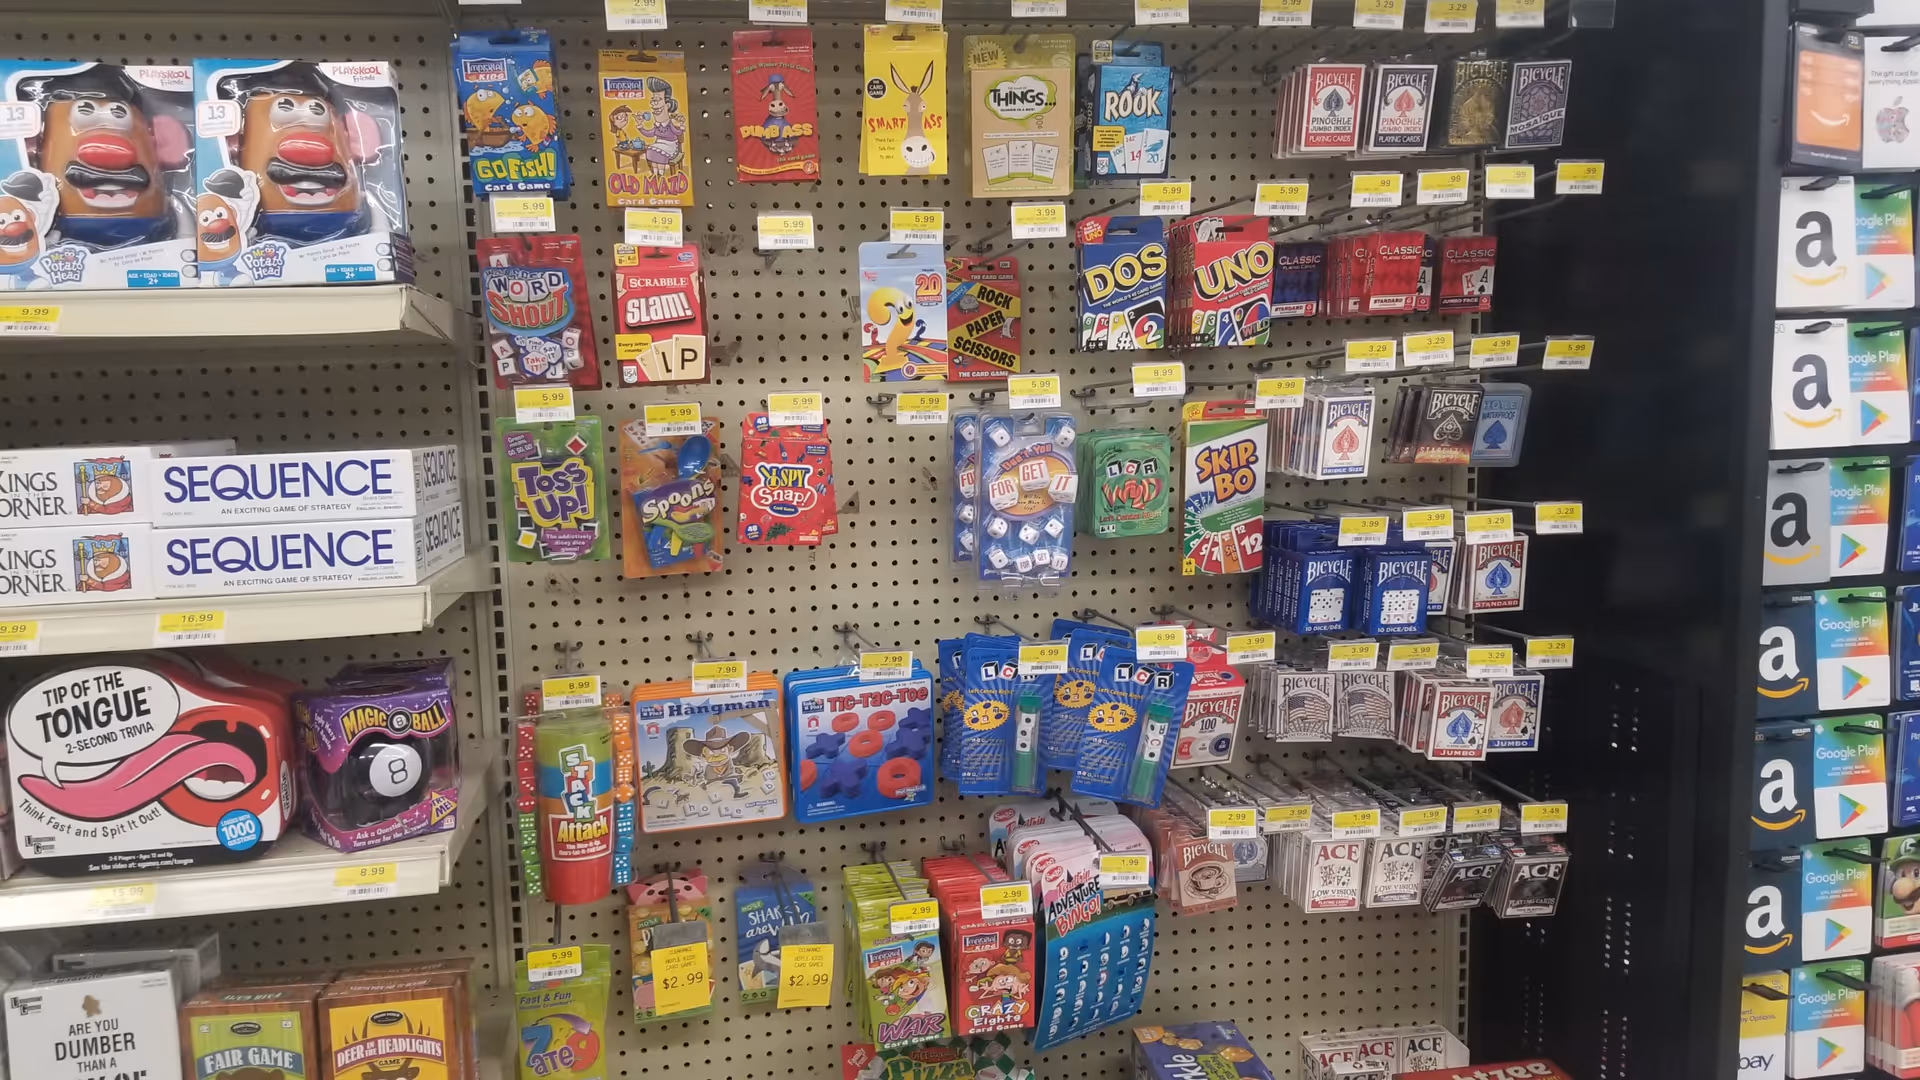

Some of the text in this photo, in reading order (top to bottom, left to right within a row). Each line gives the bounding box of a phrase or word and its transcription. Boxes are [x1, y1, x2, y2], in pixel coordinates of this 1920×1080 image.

[972, 51, 999, 64] NEW
[139, 69, 190, 80] PLAYSKOOL
[332, 65, 381, 78] PLAYSKOOL
[1455, 62, 1507, 87] BICYCLE
[1519, 67, 1565, 92] BICYCLE
[1315, 73, 1355, 94] BICYCLE
[1386, 74, 1427, 94] BICYCLE
[1104, 87, 1161, 121] ROOK
[869, 114, 942, 133] SMART ASS
[1311, 117, 1352, 125] PINOCHLE
[1381, 117, 1422, 126] PINOCHLE
[740, 123, 813, 139] DUMB ASS
[477, 159, 506, 179] GO
[485, 182, 551, 191] Card Game
[609, 174, 689, 194] OLD MAID
[651, 217, 673, 225] 4.99
[1379, 245, 1422, 255] CLASSIC
[1446, 248, 1495, 259] CLASSIC
[1279, 255, 1320, 266] CLASSIC
[50, 271, 81, 283] Head
[252, 269, 282, 281] Head
[1084, 244, 1167, 303] DOS
[1198, 244, 1274, 298] UNO
[492, 272, 562, 301] WORD
[628, 277, 688, 289] SCRABBLE
[916, 275, 941, 295] 20
[486, 287, 567, 326] SHOUT
[977, 285, 1011, 309] ROCK
[21, 308, 49, 316] 9.99
[965, 310, 1003, 336] PAPER
[1241, 319, 1269, 340] WILD
[954, 336, 1016, 369] SCISSORS
[1492, 340, 1511, 348] 4.99
[1277, 382, 1296, 390] 9.99
[1431, 392, 1480, 412] BICYCLE
[1330, 403, 1369, 421] BICYCLE
[424, 450, 457, 486] SEQUENCE
[782, 468, 807, 487] SPY
[164, 458, 393, 503] SEQUENCE
[992, 462, 1071, 498] FOR GET IT
[1214, 473, 1254, 497] BO
[643, 479, 715, 522] Spoons
[759, 488, 810, 505] Snap!
[235, 506, 271, 514] EXCITING
[311, 503, 352, 511] STRATEGY
[425, 507, 461, 552] SEQUENCE
[167, 529, 394, 575] SEQUENCE
[1242, 535, 1263, 554] 12
[1479, 543, 1521, 561] BICYCLE
[1307, 560, 1352, 584] BICYCLE
[1378, 560, 1426, 585] BICYCLE
[1475, 600, 1520, 608] STANDARD
[181, 613, 214, 623] 16.99
[1819, 616, 1883, 631] Google Play
[1351, 646, 1369, 654] 3.99
[717, 666, 737, 674] 7.99
[43, 671, 123, 707] TIP OF THE
[1283, 676, 1330, 694] BICYCLE
[1341, 673, 1390, 694] BICYCLE
[1494, 683, 1536, 700] BICYCLE
[668, 698, 770, 716] Hangman
[1185, 698, 1237, 724] BICYCLE
[1441, 694, 1487, 713] BICYCLE
[36, 688, 151, 742] TONGUE
[342, 707, 446, 738] MAGIC 8 BALL
[65, 722, 154, 754] 2-SECOND TRIVIA
[1440, 749, 1474, 757] JUMBO
[1816, 745, 1880, 760] Google Play
[389, 758, 408, 784] 8
[18, 799, 161, 839] Think Fast and Spit It Out!
[1423, 810, 1439, 818] 1.99
[221, 820, 255, 840] 1000
[557, 822, 609, 844] Attack
[1182, 842, 1228, 865] BICYCLE
[1317, 843, 1359, 863] ACE
[1379, 841, 1423, 860] ACE
[360, 867, 385, 876] 8.99
[1453, 865, 1496, 881] ACE
[1514, 864, 1560, 881] ACE
[1049, 876, 1100, 924] ADVENTURE
[912, 906, 931, 914] 2.99
[552, 952, 572, 960] 5.99
[663, 973, 703, 989] $2.99
[789, 974, 828, 987] $2.99
[1798, 992, 1838, 1004] Google
[965, 1002, 1027, 1019] CRAZY
[973, 1014, 1020, 1026] Eights
[69, 1019, 118, 1036] ARE YOU
[878, 1013, 943, 1041] WAR
[55, 1032, 136, 1060] DUMBER
[337, 1048, 364, 1067] DEER
[377, 1038, 441, 1058] HEADLIGHTS
[1357, 1041, 1395, 1059] ACE
[1406, 1038, 1443, 1055] ACE
[204, 1047, 294, 1075] FAIR GAME
